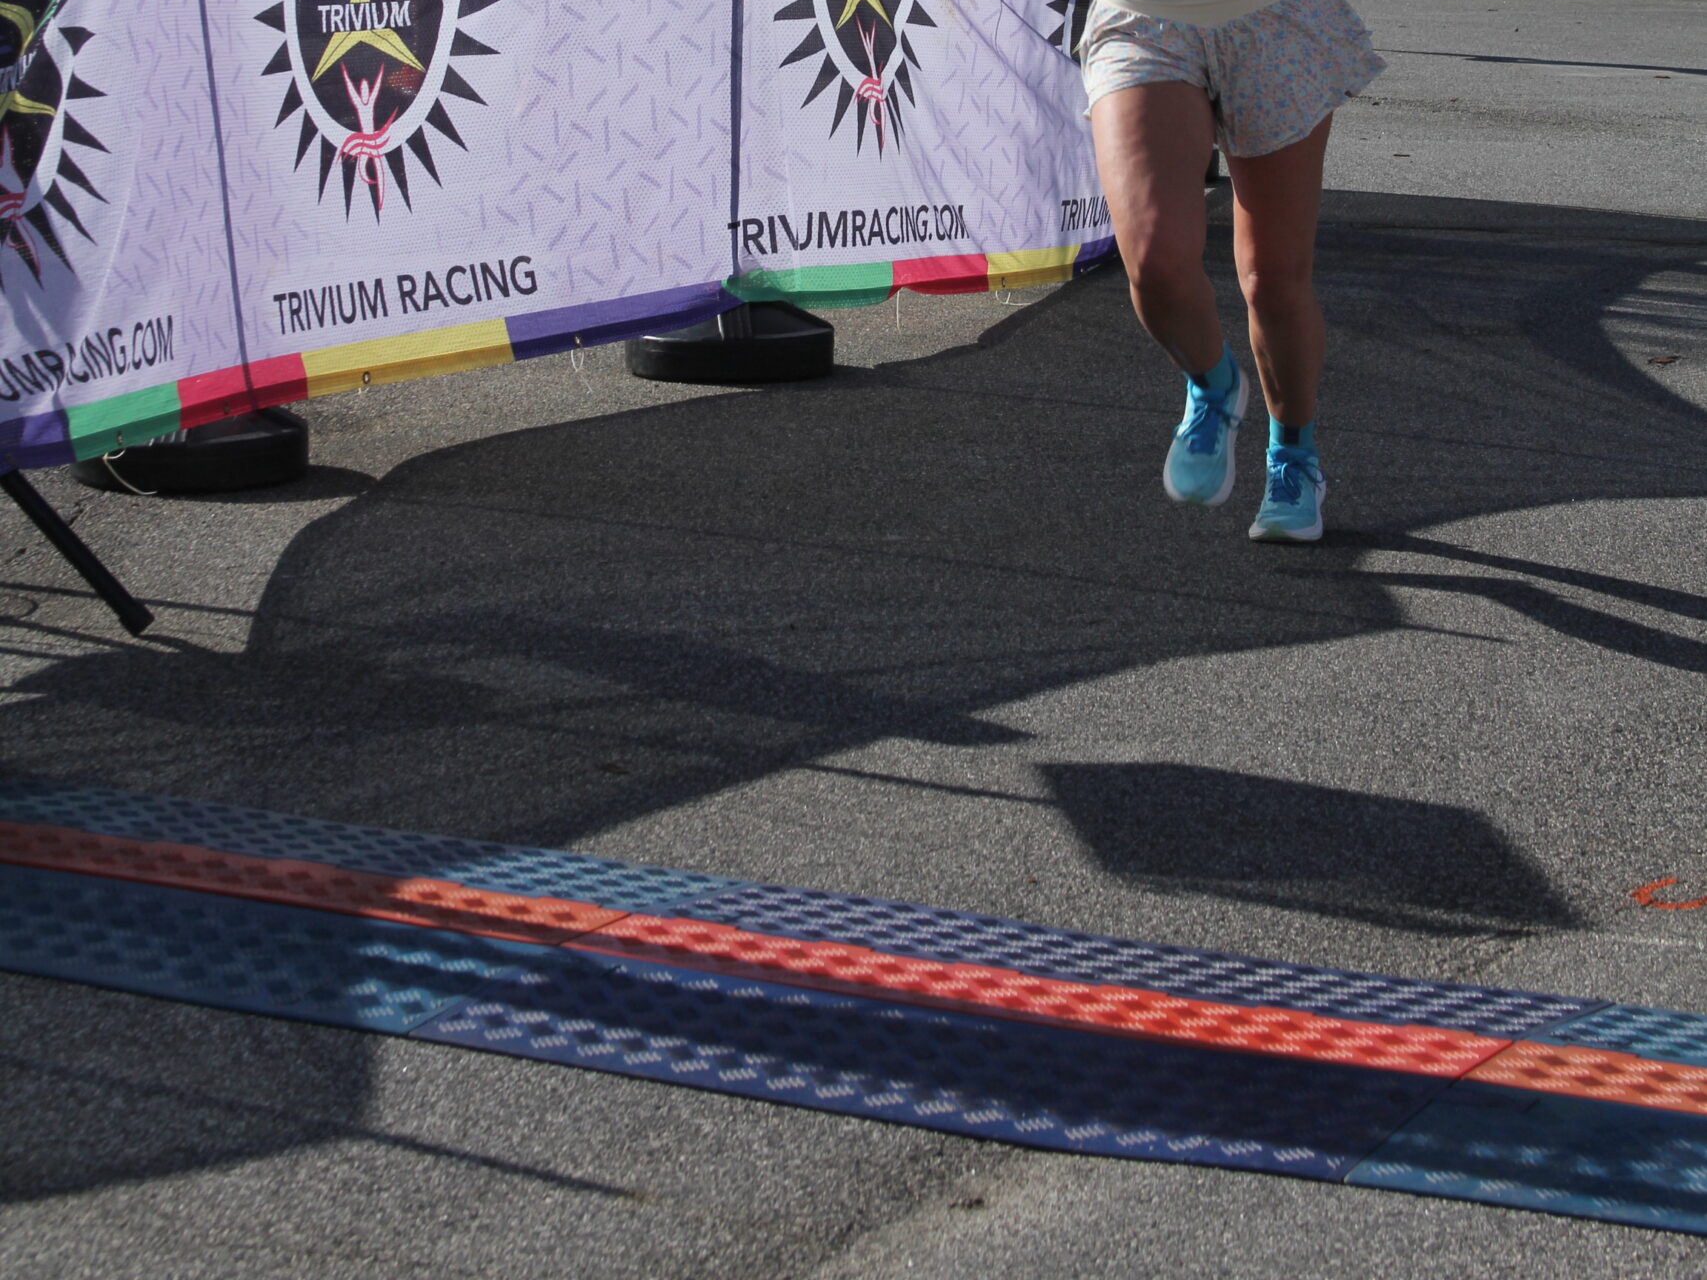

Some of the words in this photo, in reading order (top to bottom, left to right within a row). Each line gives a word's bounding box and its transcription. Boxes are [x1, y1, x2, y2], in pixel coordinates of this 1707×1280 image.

[317, 0, 412, 33] TRIVIUM
[727, 204, 970, 255] TRIVUMRACING.COM
[273, 278, 389, 335] TRIVIUM
[397, 255, 538, 314] RACING
